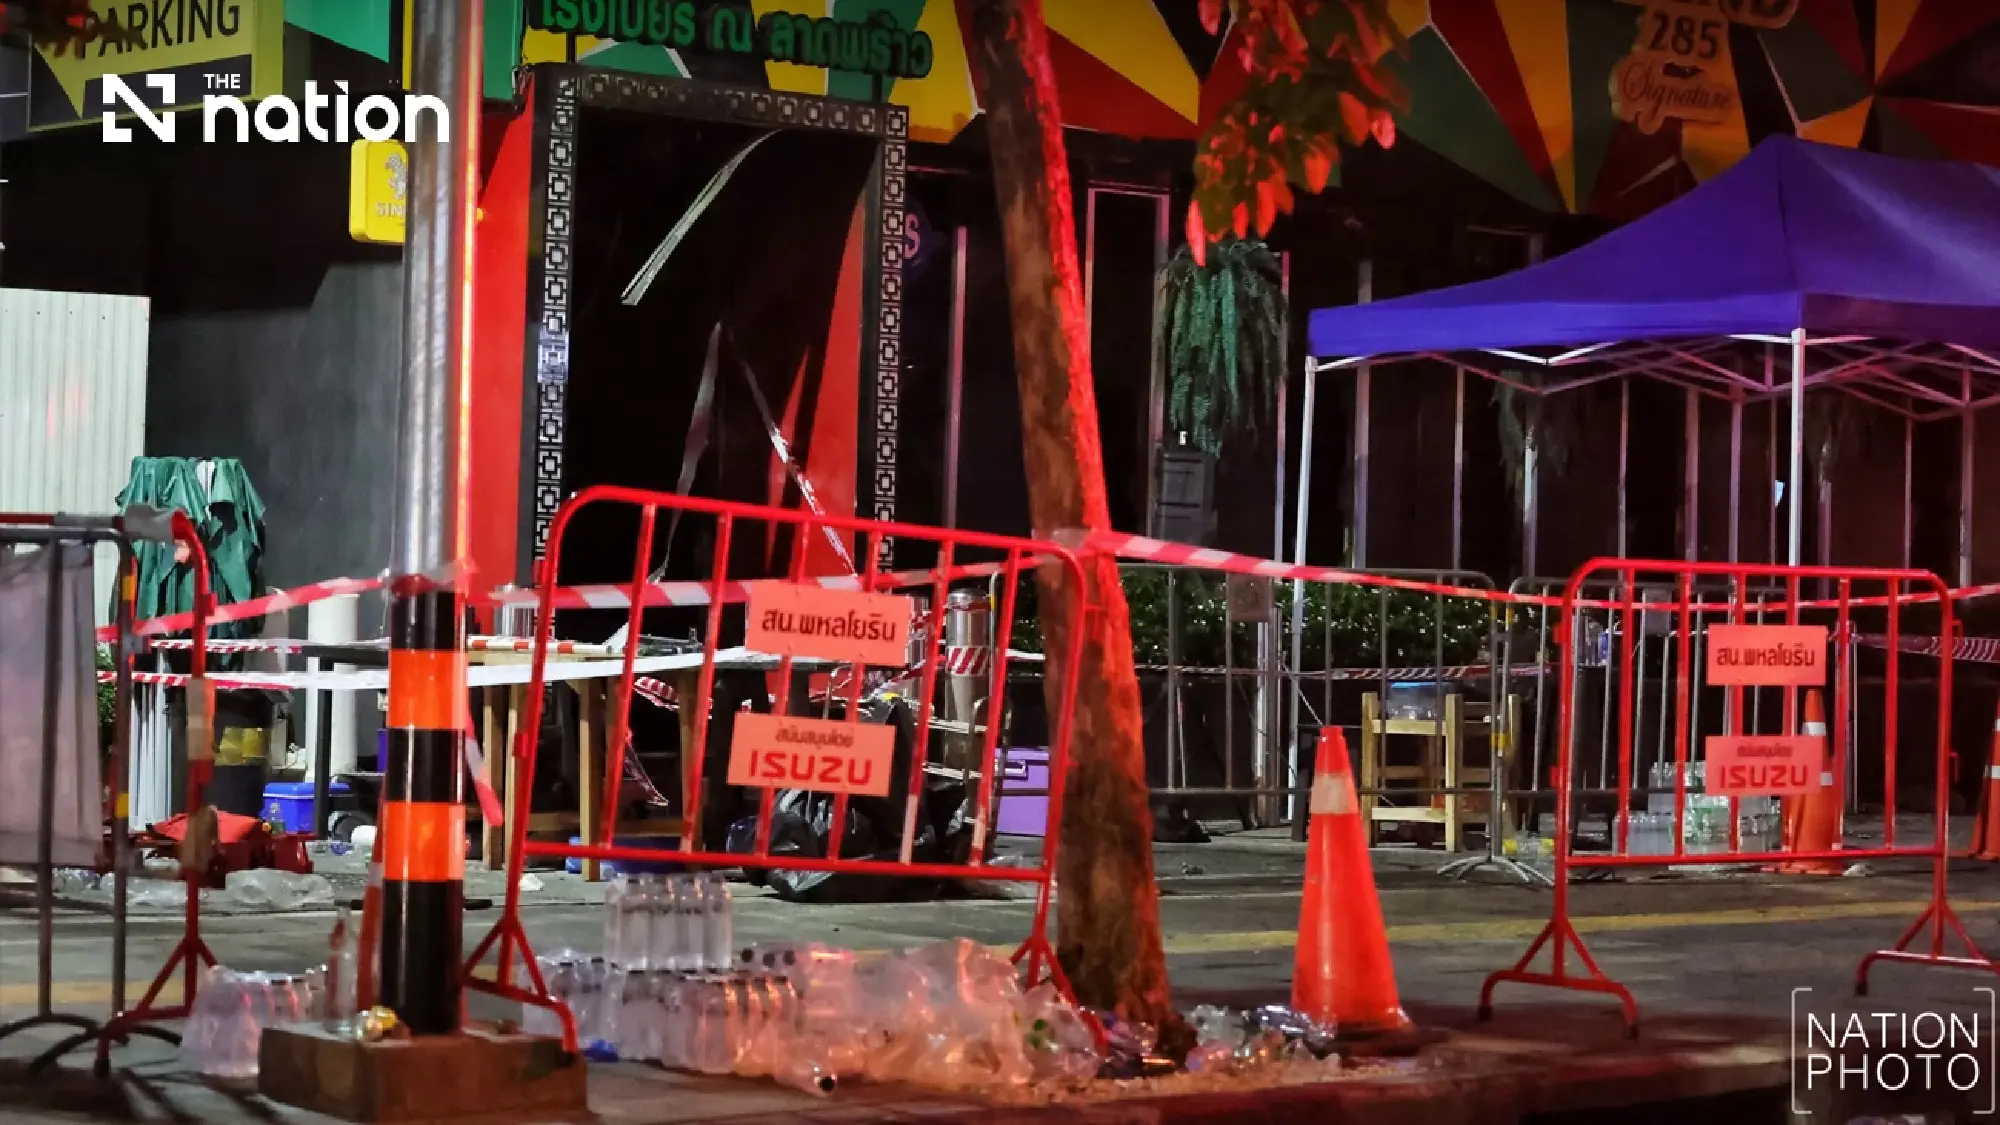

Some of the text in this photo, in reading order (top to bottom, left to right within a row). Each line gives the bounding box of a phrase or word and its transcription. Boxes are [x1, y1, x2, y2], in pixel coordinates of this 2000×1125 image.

[76, 0, 241, 59] PARKING
[1649, 12, 1721, 58] 285
[749, 749, 872, 786] ISUZU
[1720, 764, 1808, 789] ISUZU
